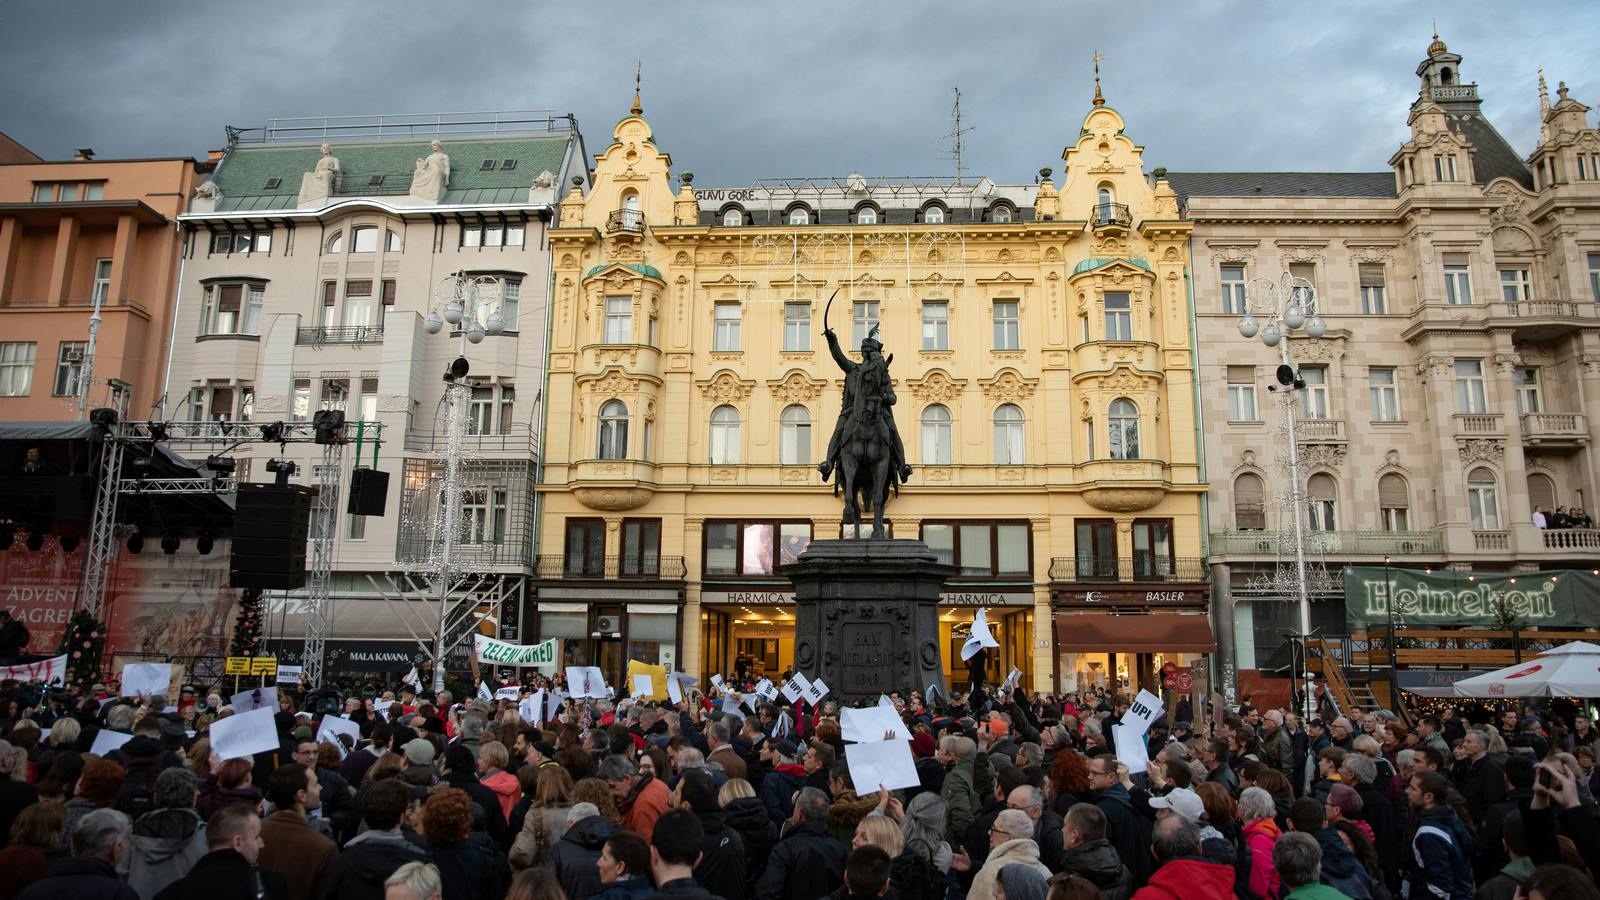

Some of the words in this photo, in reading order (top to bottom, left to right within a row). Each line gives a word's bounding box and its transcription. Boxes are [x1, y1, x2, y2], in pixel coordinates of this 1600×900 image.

[5, 585, 79, 603] ADVENT
[727, 592, 785, 604] HARMICA
[947, 593, 1006, 605] HARMICA
[1146, 591, 1184, 601] BASLER
[1364, 580, 1556, 618] Heineken
[349, 652, 374, 661] MALA
[375, 652, 409, 661] KAVANA
[482, 642, 521, 664] ZELENI
